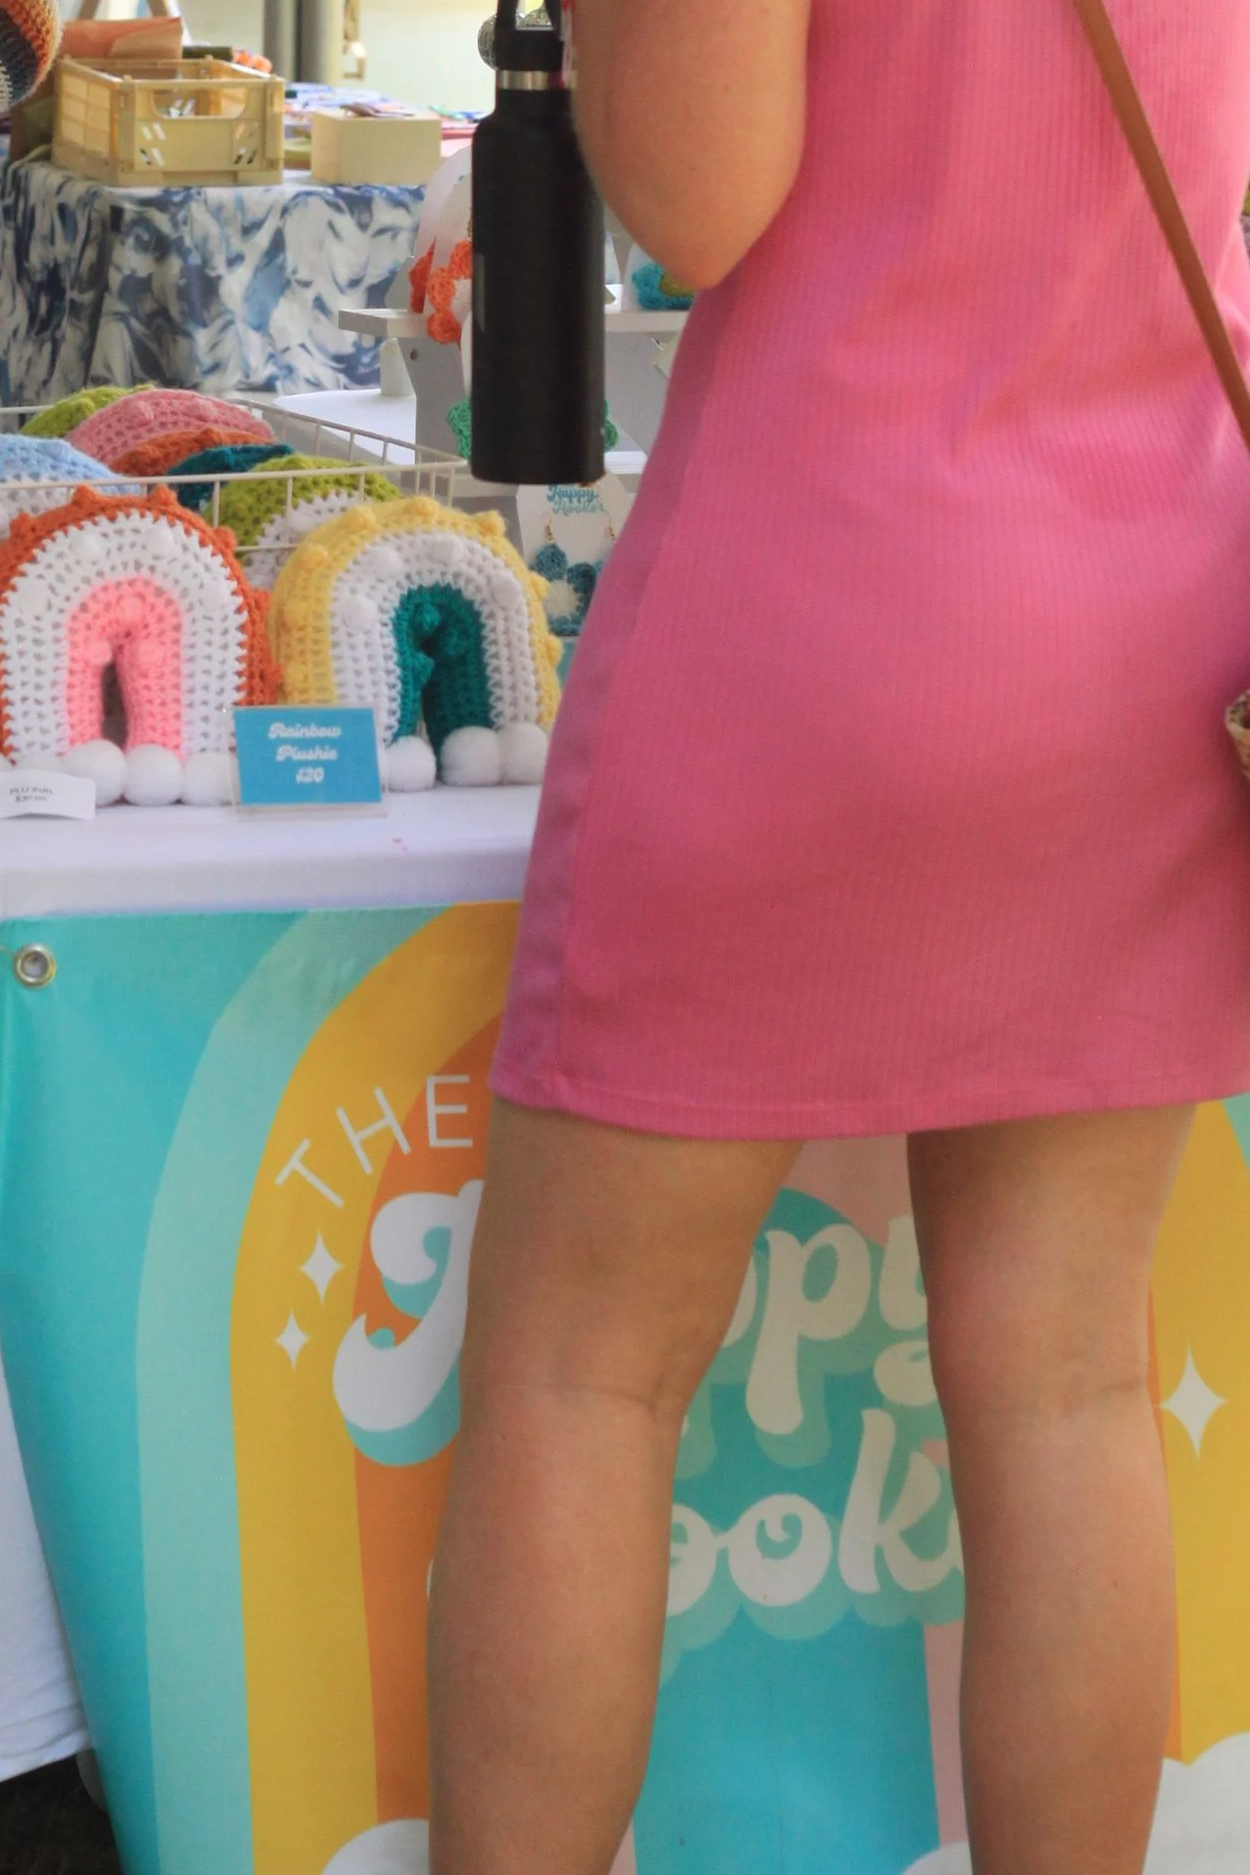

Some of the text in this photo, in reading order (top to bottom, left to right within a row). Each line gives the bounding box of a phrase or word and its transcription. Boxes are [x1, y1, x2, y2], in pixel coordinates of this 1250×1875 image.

[269, 722, 341, 739] Rainbow
[277, 745, 337, 761] Plushie
[296, 767, 324, 783] $20
[277, 1075, 473, 1208] THE
